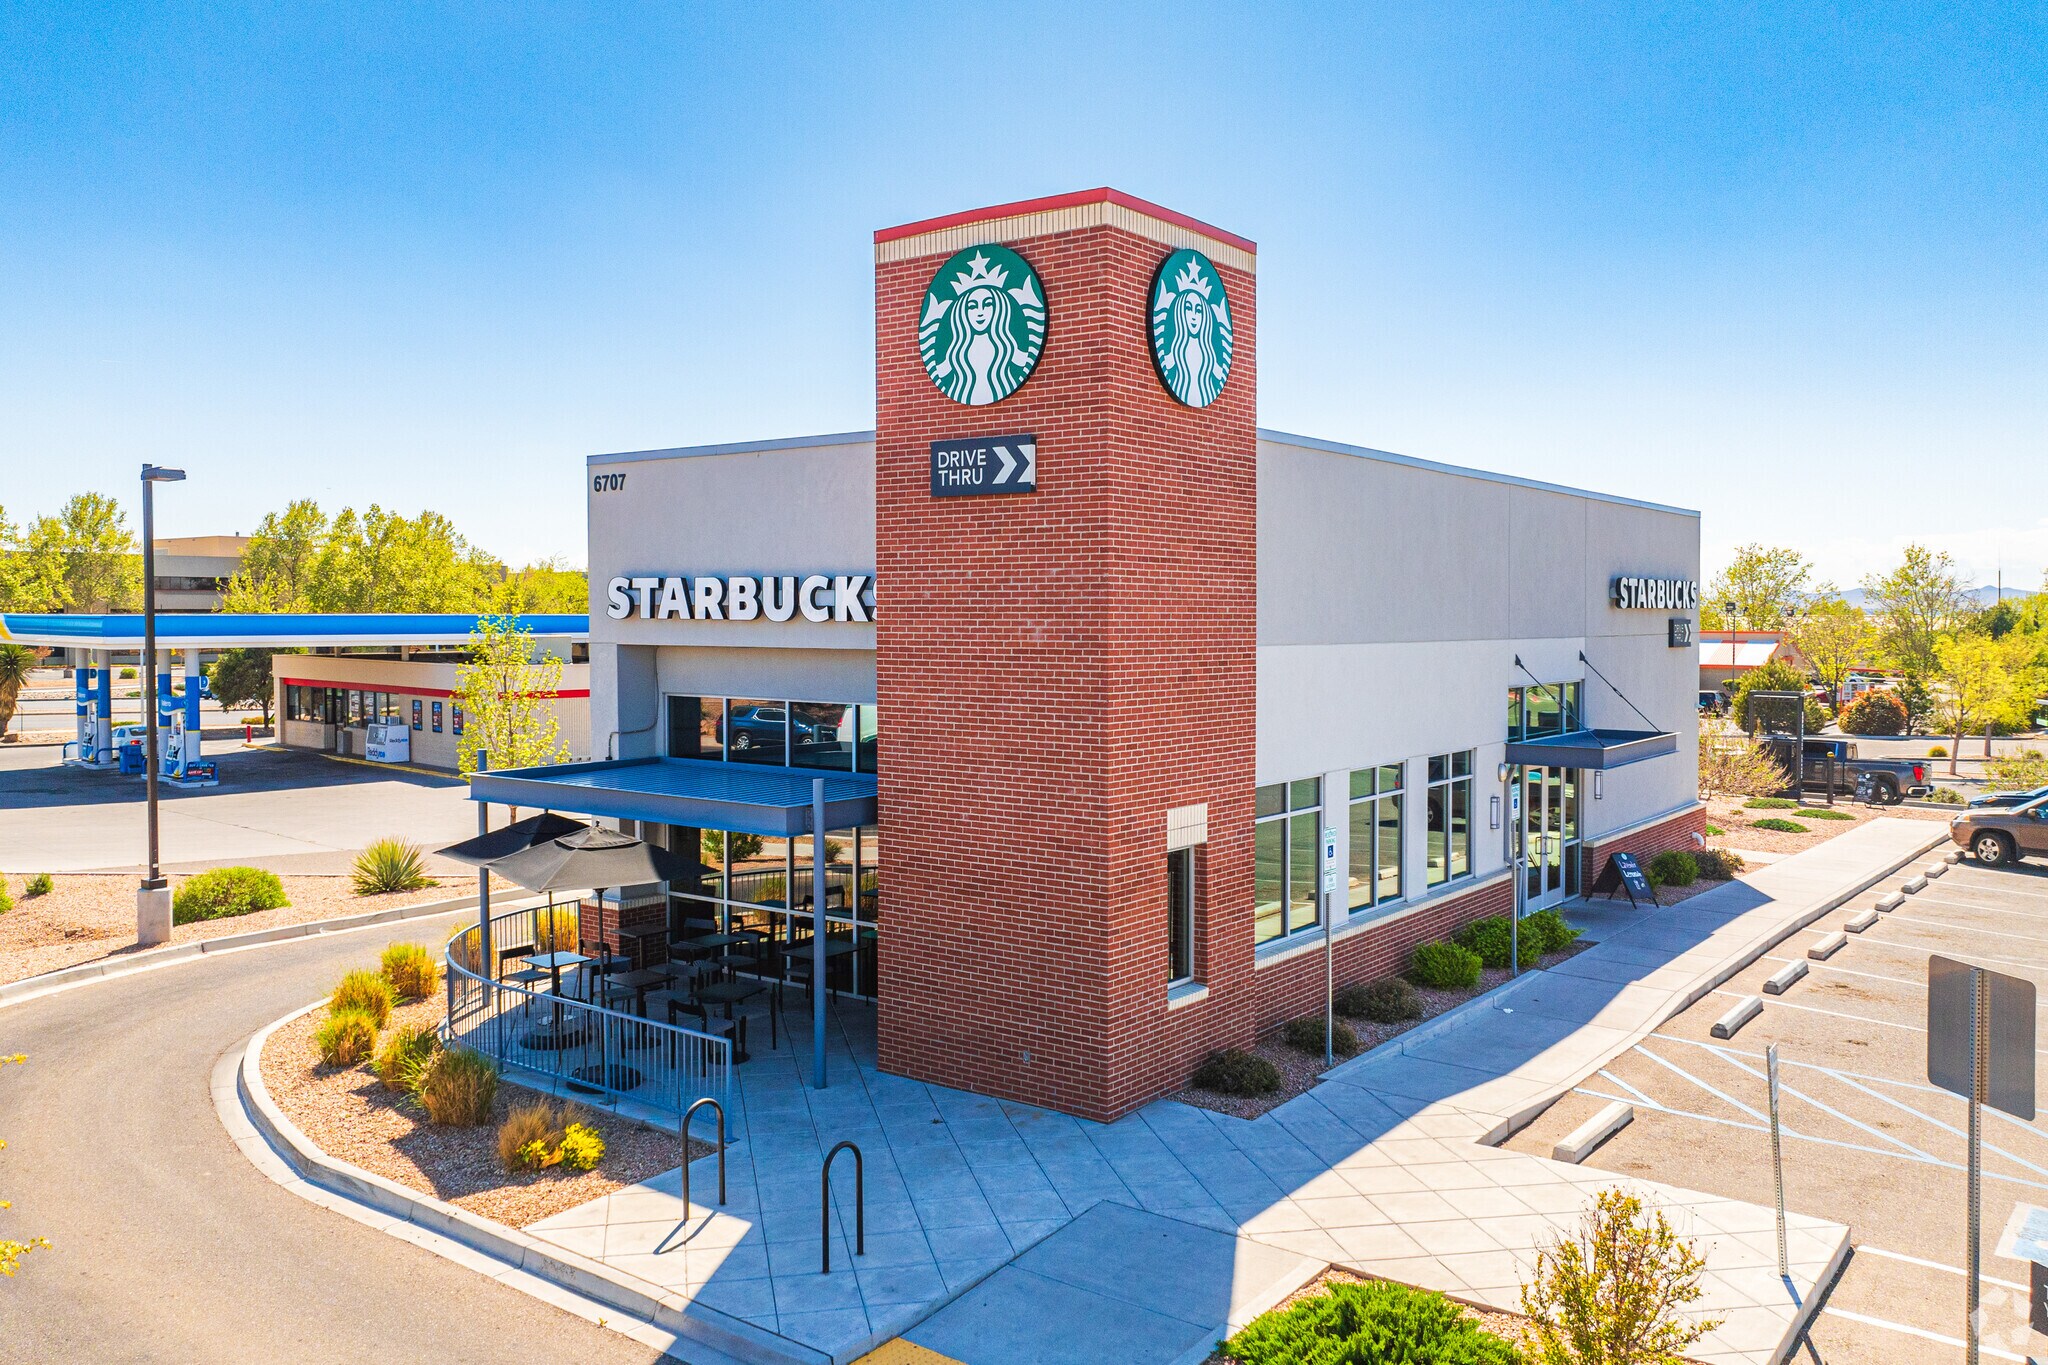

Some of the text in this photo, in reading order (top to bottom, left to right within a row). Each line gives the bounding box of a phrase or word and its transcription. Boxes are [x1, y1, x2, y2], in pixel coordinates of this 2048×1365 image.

[937, 448, 987, 468] DRIVE
[593, 473, 627, 493] 6707
[937, 467, 983, 487] THRU
[606, 574, 877, 623] STARBUCK
[1617, 576, 1698, 610] STARBUCKS
